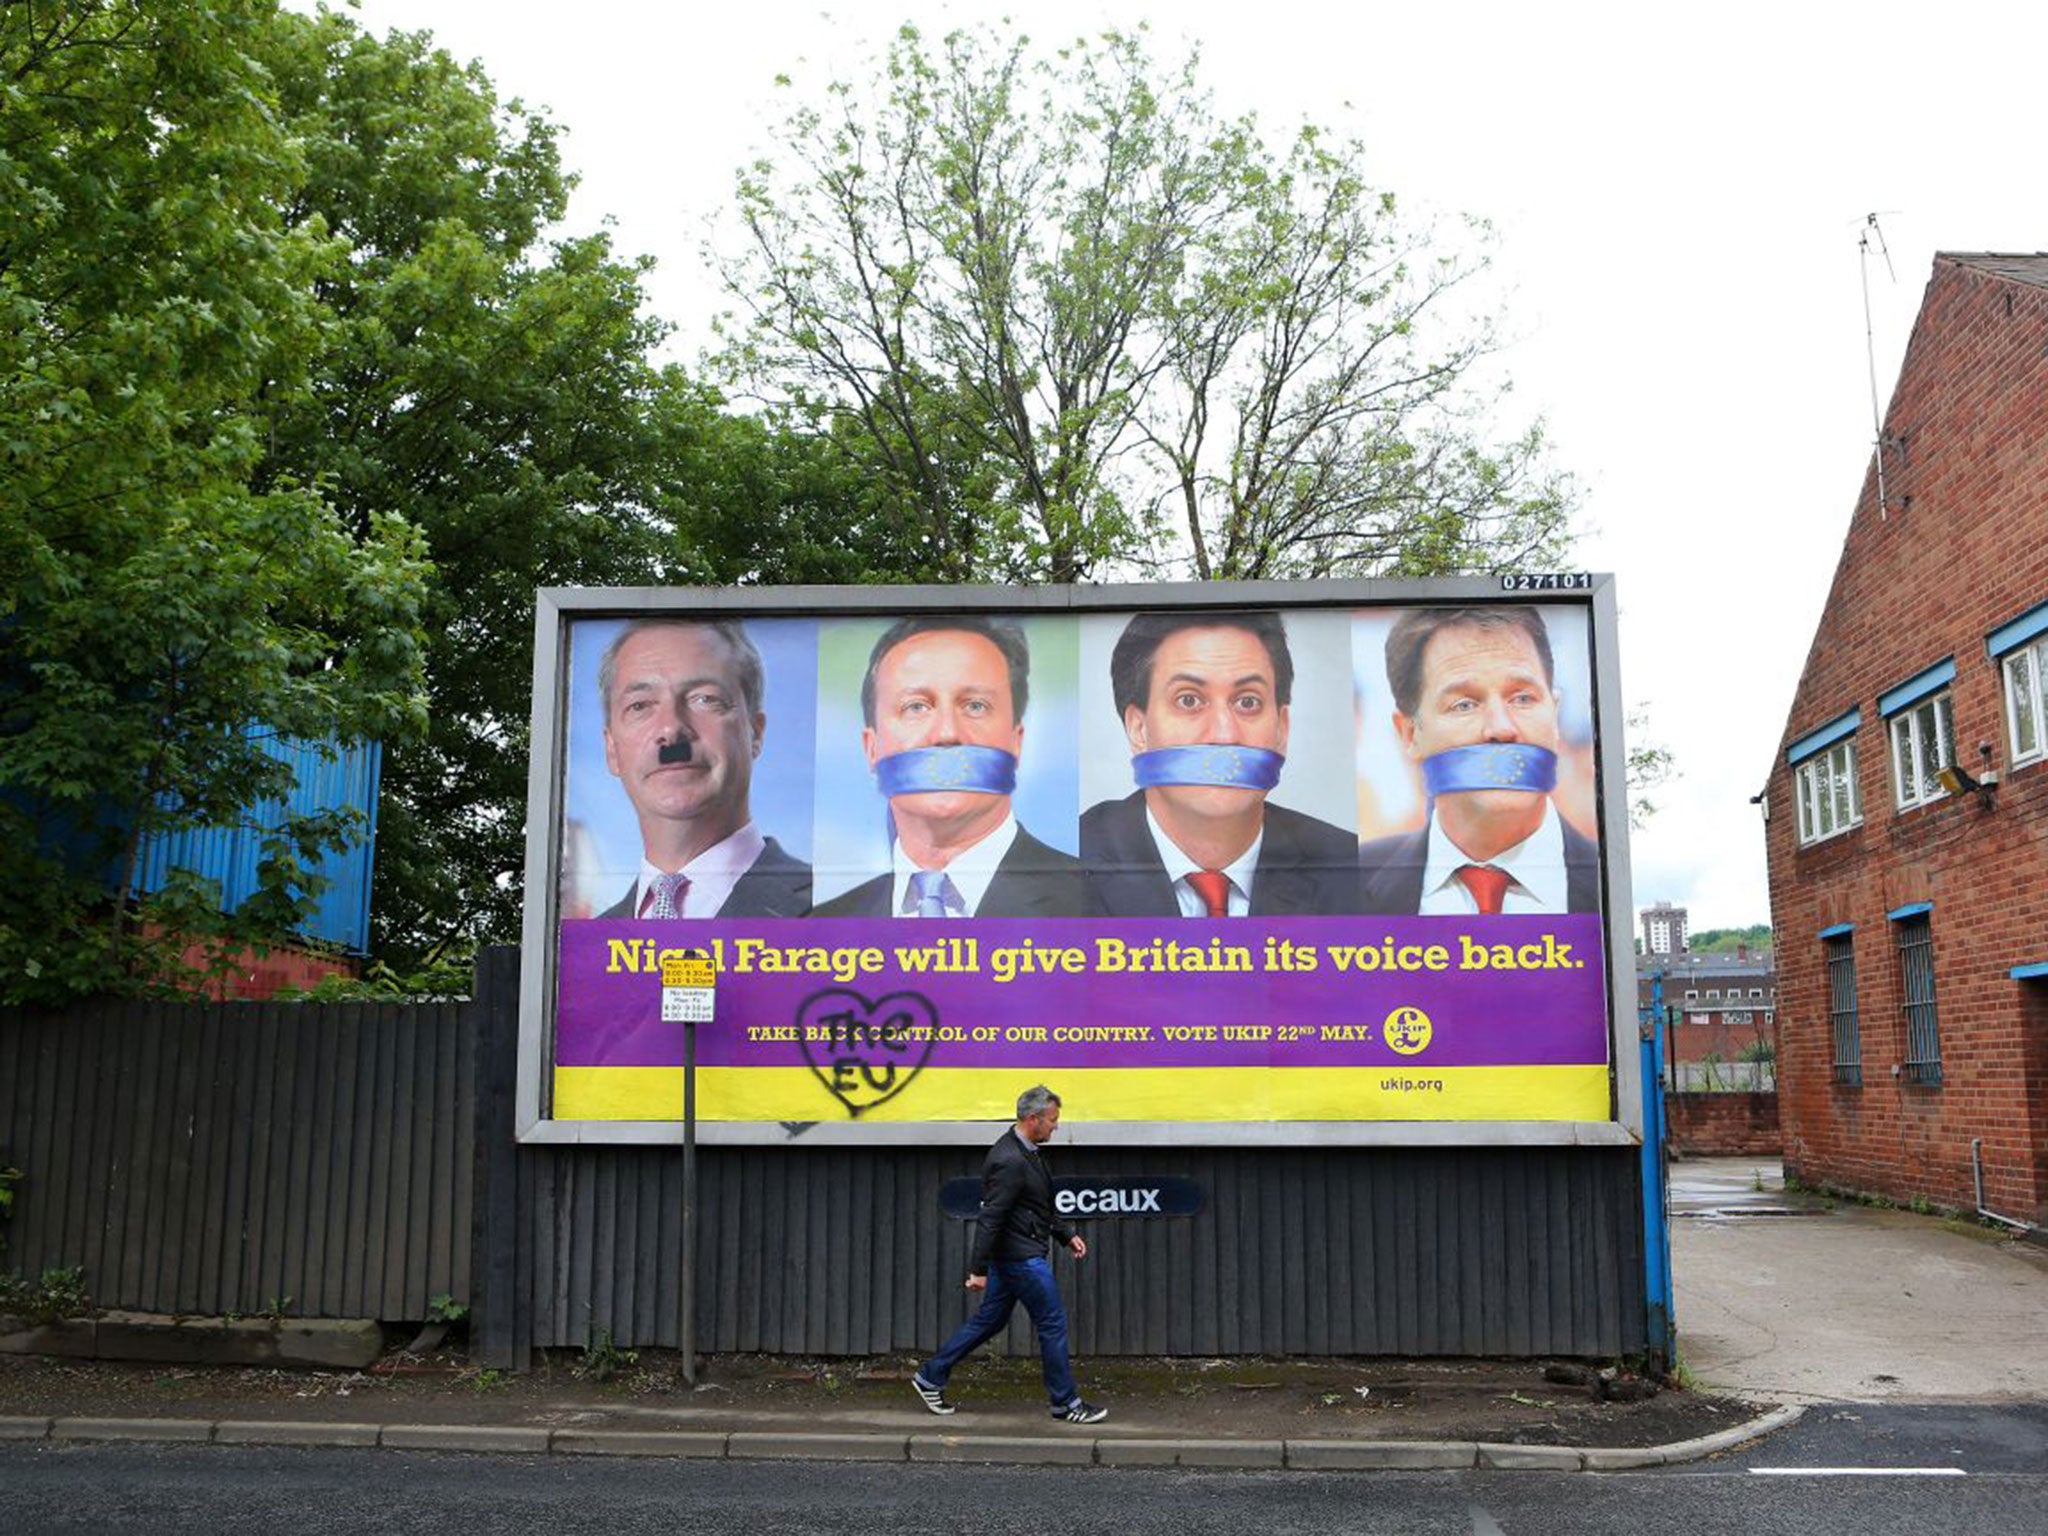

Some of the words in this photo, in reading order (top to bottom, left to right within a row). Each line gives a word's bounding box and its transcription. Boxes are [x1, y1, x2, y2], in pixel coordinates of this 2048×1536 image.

[1503, 575, 1589, 590] 027101
[733, 937, 885, 983] Farage
[893, 937, 981, 973] will
[990, 937, 1087, 983] give
[1094, 936, 1254, 972] Britain
[1263, 936, 1319, 972] its
[1326, 935, 1450, 972] voice
[1458, 934, 1584, 971] back.
[747, 1026, 800, 1042] TAKE
[971, 1026, 1001, 1042] OF
[1004, 1026, 1049, 1042] OUR
[1052, 1026, 1155, 1042] COUNTRY.
[1161, 1025, 1218, 1042] VOTE
[1222, 1025, 1273, 1042] UKIP
[1320, 1025, 1373, 1042] MAY.
[817, 1009, 914, 1053] The
[1389, 1024, 1427, 1033] UKIP
[832, 1057, 896, 1093] EU
[1380, 1077, 1444, 1093] ukip.org
